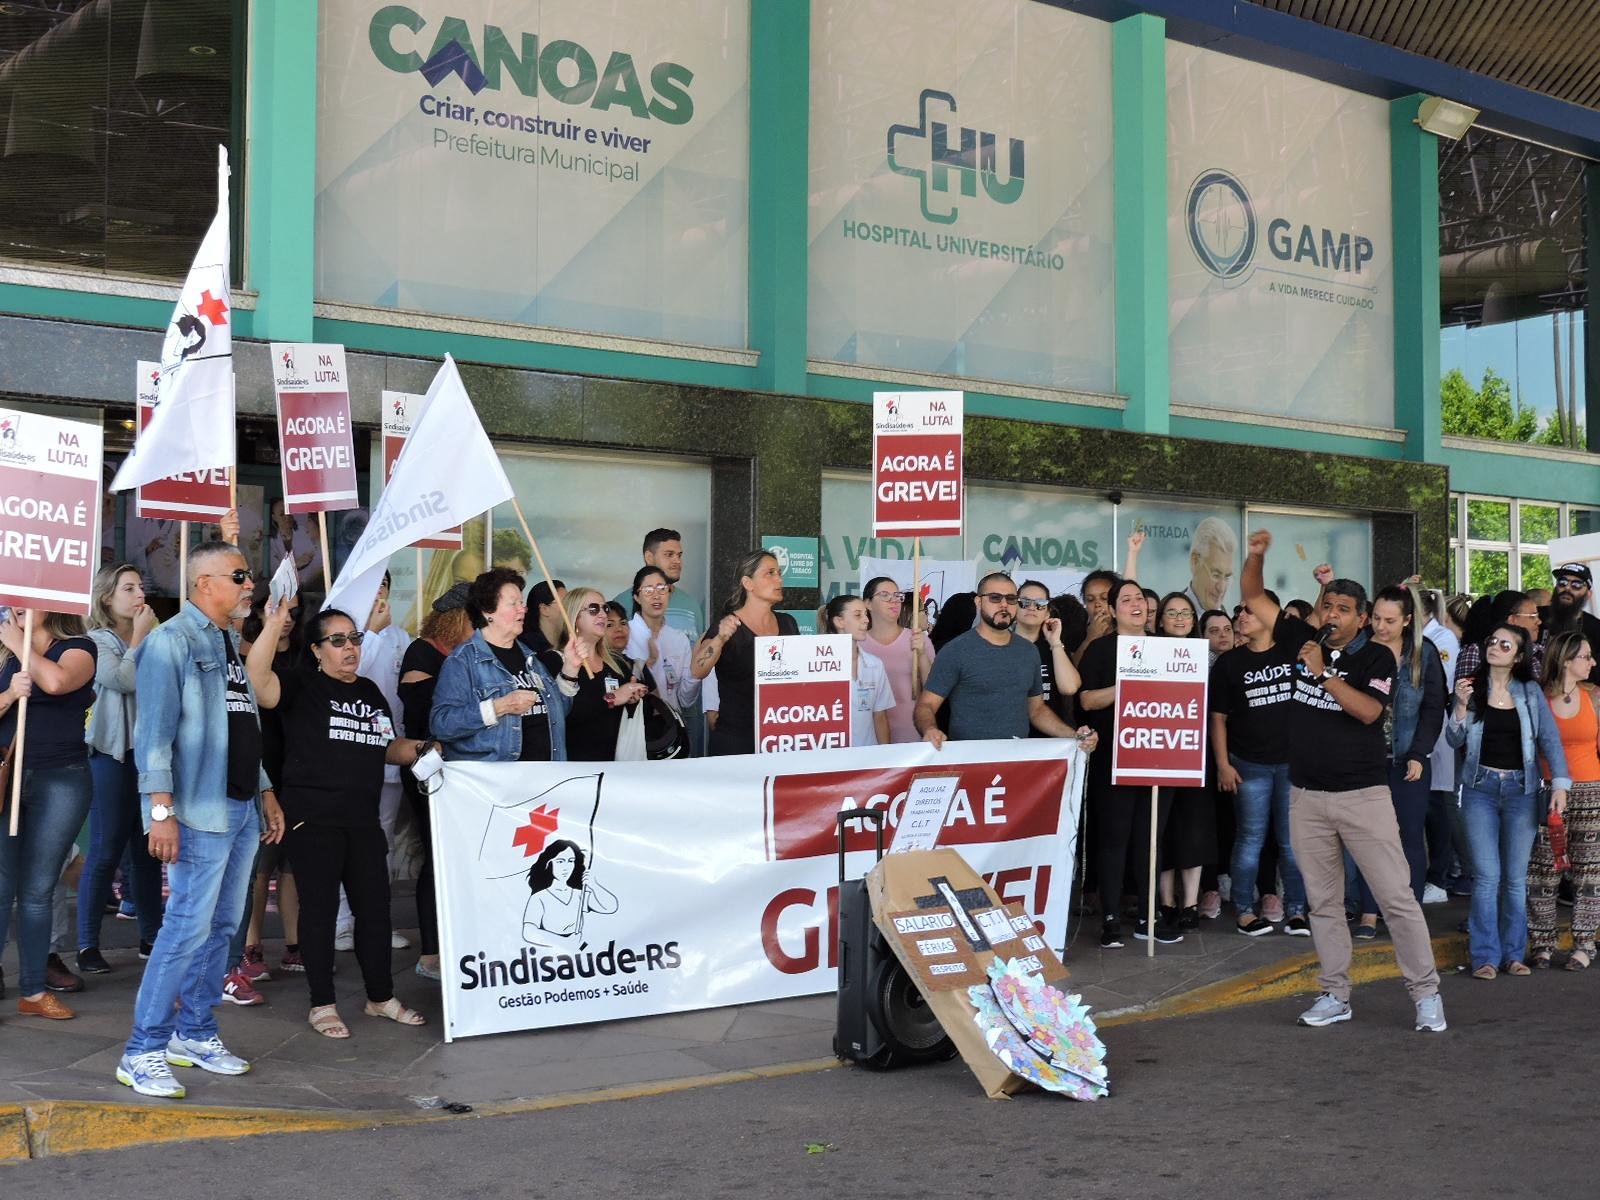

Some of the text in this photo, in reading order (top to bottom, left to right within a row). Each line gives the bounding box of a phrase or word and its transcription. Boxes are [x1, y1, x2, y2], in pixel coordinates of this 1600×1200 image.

[369, 5, 694, 125] CANOAS
[419, 95, 651, 153] Criar, construir e viver
[434, 128, 639, 182] Prefeitura Municipal
[932, 121, 1025, 205] HU
[843, 219, 1064, 271] HOSPITAL UNIVERSITÁRIO
[1267, 218, 1374, 274] GAMP
[1269, 281, 1374, 310] A VIDA MERECE CUIDADO
[319, 354, 333, 367] NA
[315, 371, 340, 383] LUTA!
[930, 401, 946, 412] NA
[286, 410, 346, 436] AGORA É
[922, 415, 953, 426] LUTA!
[58, 431, 80, 448] NA
[48, 448, 88, 468] LUTA!
[286, 446, 350, 472] GREVE!
[880, 450, 955, 473] AGORA É
[878, 480, 957, 503] GREVE!
[74, 500, 87, 527] É
[0, 530, 88, 568] REVE!
[983, 533, 1098, 568] CANOAS
[816, 645, 834, 657] NA
[1174, 647, 1190, 659] NA
[808, 660, 841, 673] LUTA!
[1166, 662, 1197, 673] LUTA!
[1243, 663, 1291, 684] SAÚDE
[763, 699, 844, 724] AGORA É
[1122, 698, 1198, 719] AGORA É
[1119, 727, 1199, 750] GREVE!
[984, 774, 1007, 826] É
[459, 940, 682, 990] Sindisaúde-RS
[224, 982, 238, 996] N
[498, 992, 542, 1009] Gestão
[544, 987, 600, 1005] Podemos
[612, 980, 649, 996] Saúde
